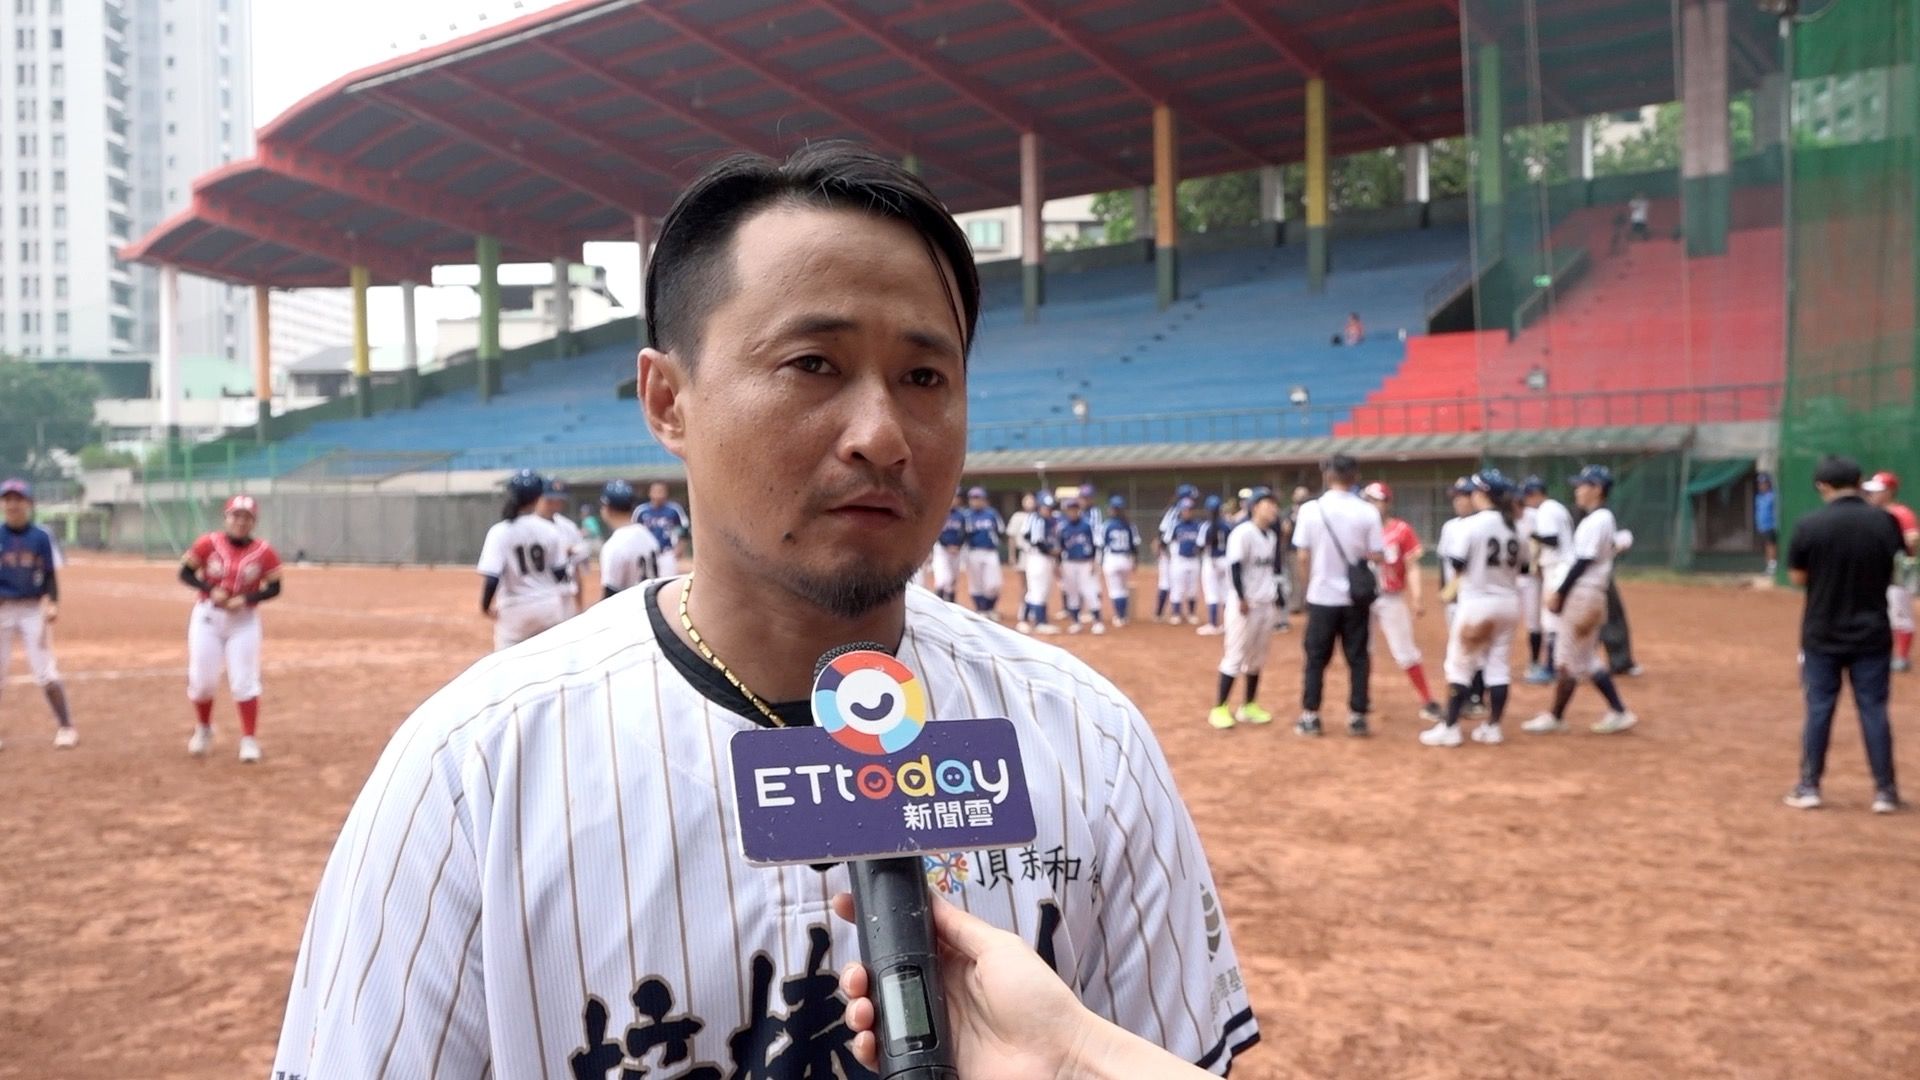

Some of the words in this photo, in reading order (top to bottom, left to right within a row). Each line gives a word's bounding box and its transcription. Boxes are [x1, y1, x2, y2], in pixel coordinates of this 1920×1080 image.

[1487, 537, 1519, 567] 29
[754, 754, 1009, 807] ETtoday
[903, 799, 994, 830] 新聞雲
